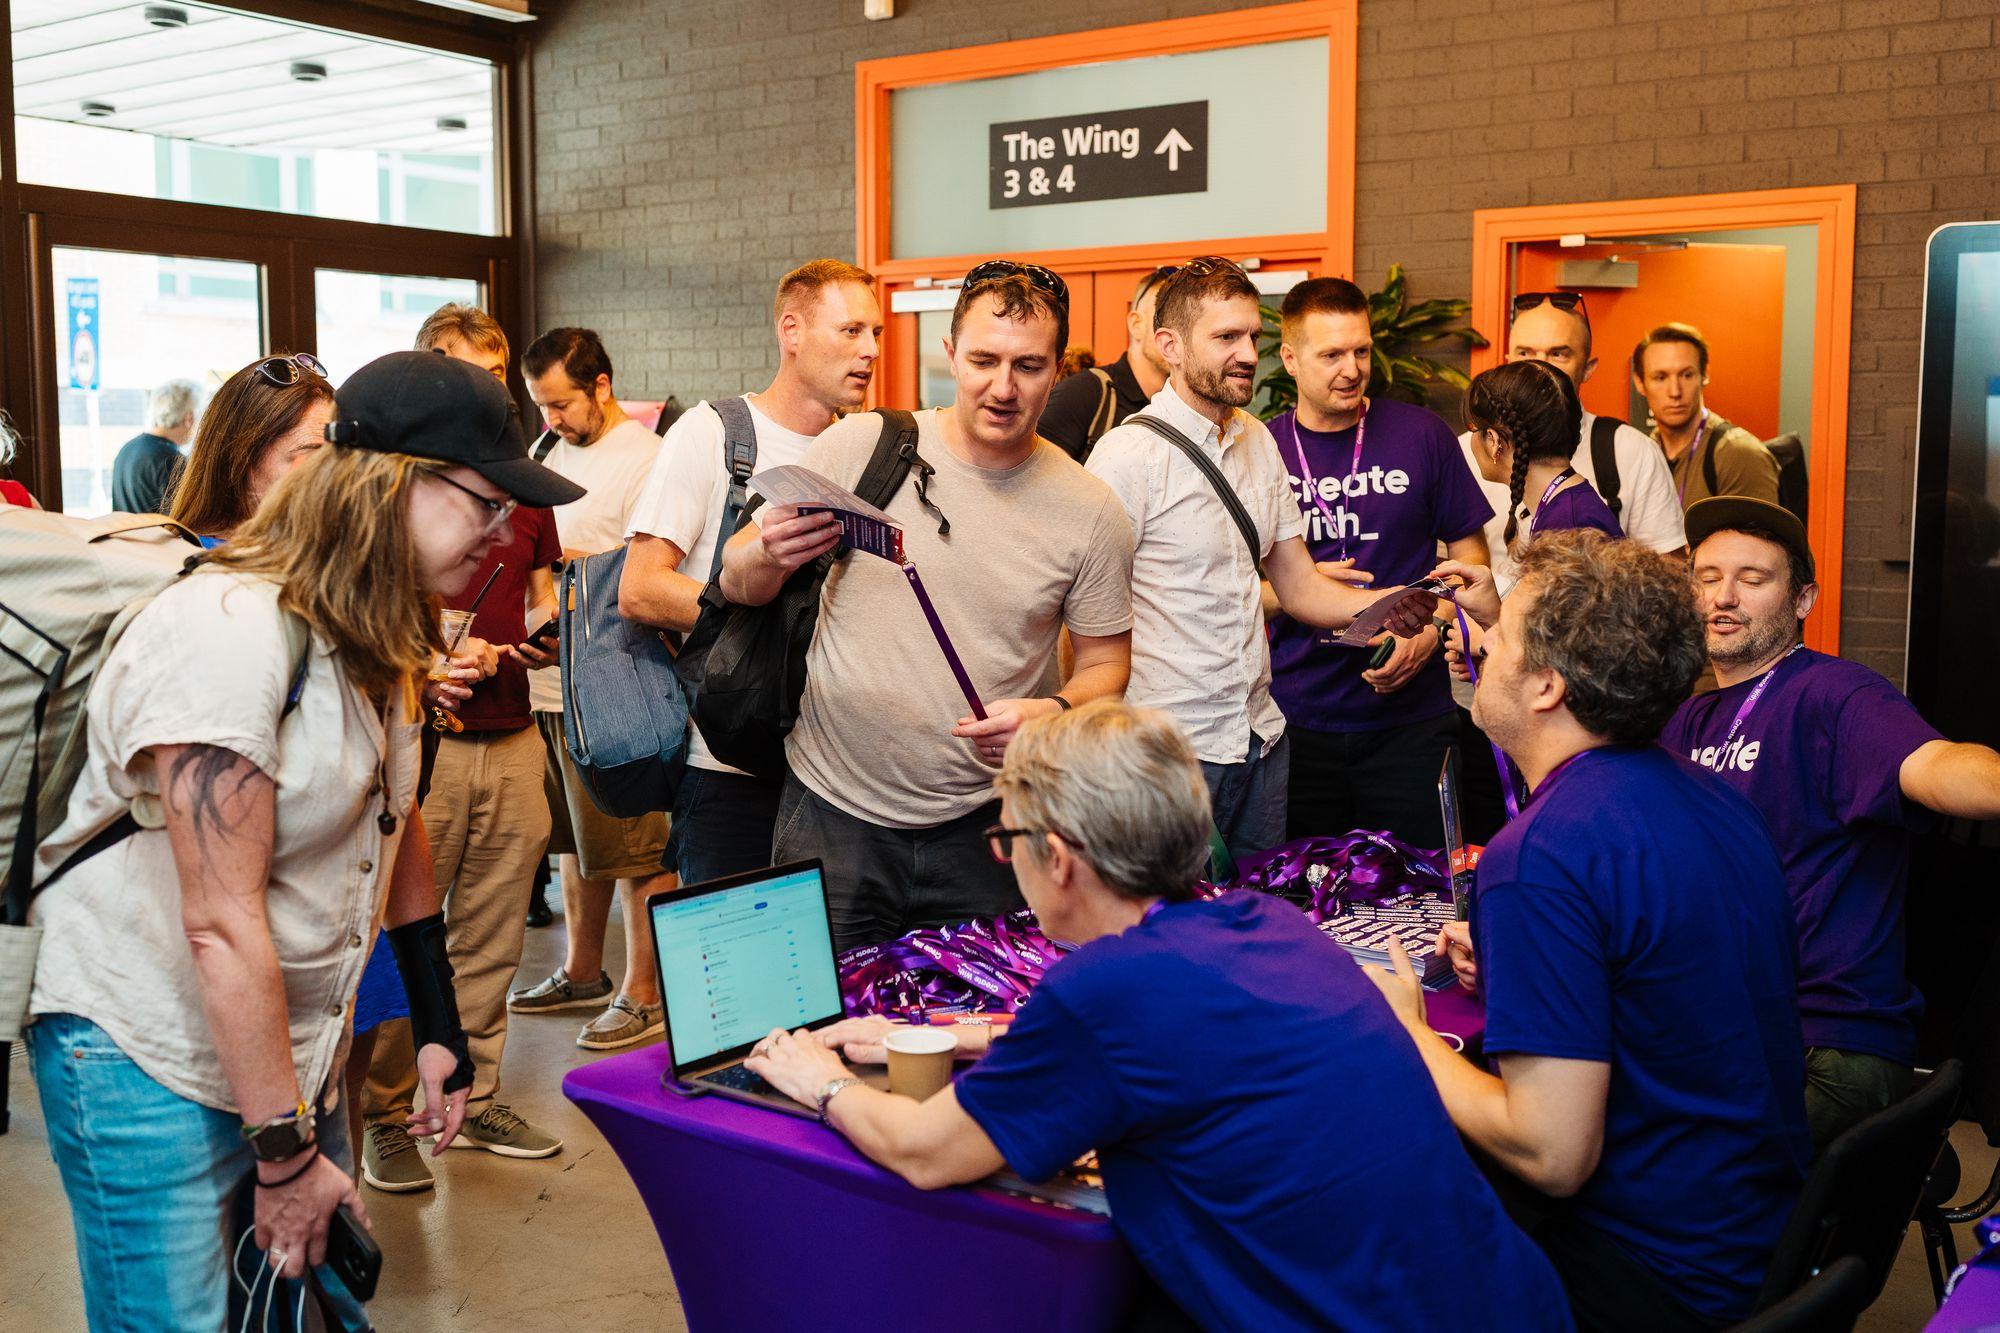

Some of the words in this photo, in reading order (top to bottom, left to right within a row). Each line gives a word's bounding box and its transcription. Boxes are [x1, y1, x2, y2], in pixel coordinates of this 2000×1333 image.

[1003, 131, 1055, 162] The
[1062, 124, 1140, 159] Wing
[1003, 169, 1021, 198] 3
[1028, 166, 1051, 196] &
[1056, 164, 1076, 193] 4
[1758, 670, 1775, 688] Create
[1727, 718, 1743, 740] Create
[838, 954, 855, 965] With_
[855, 946, 879, 958] Create
[1019, 950, 1042, 965] Create
[956, 963, 973, 979] With_
[973, 975, 999, 993] Create
